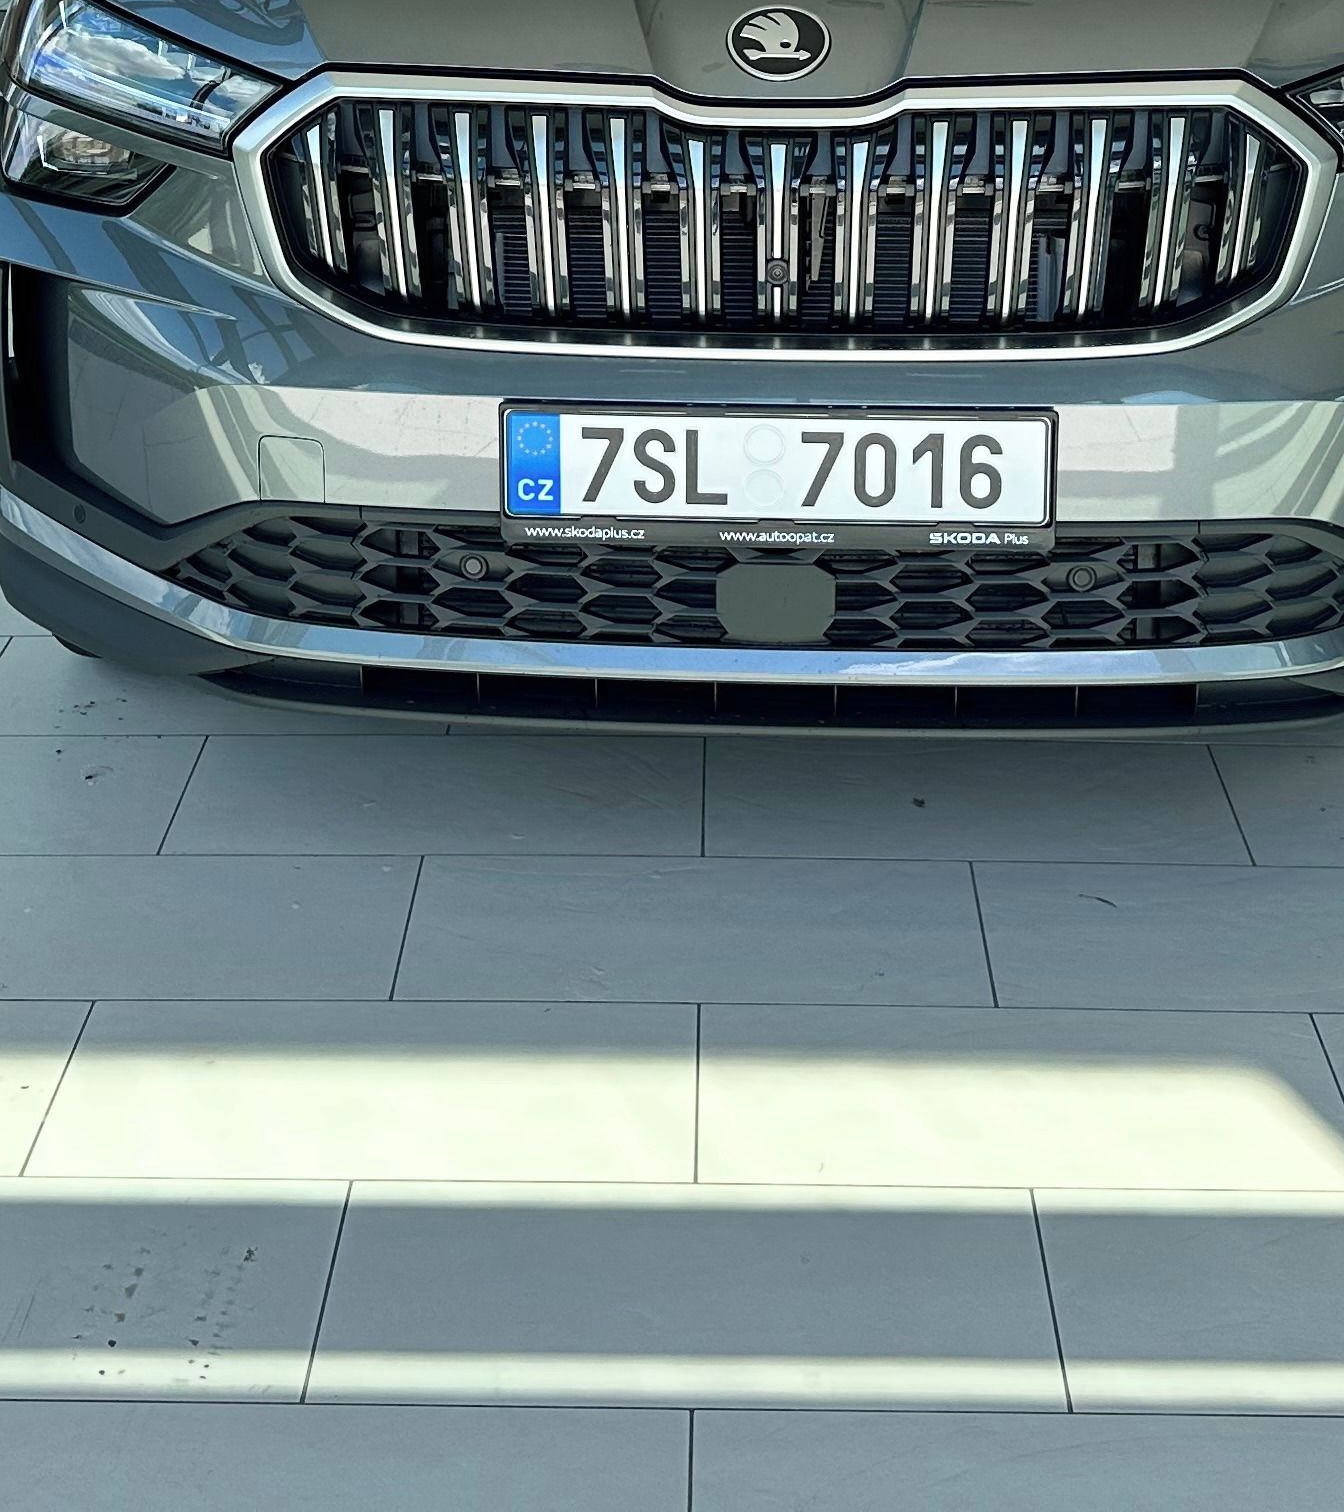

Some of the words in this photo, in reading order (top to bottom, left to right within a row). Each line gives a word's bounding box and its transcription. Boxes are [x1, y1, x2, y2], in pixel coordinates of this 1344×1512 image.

[581, 426, 728, 506] 7SL
[800, 431, 1004, 509] 7016
[517, 478, 554, 501] CZ
[524, 525, 646, 541] www.skodaplus.cz
[719, 530, 835, 545] www.autoopat.cz
[1004, 532, 1029, 544] Plus
